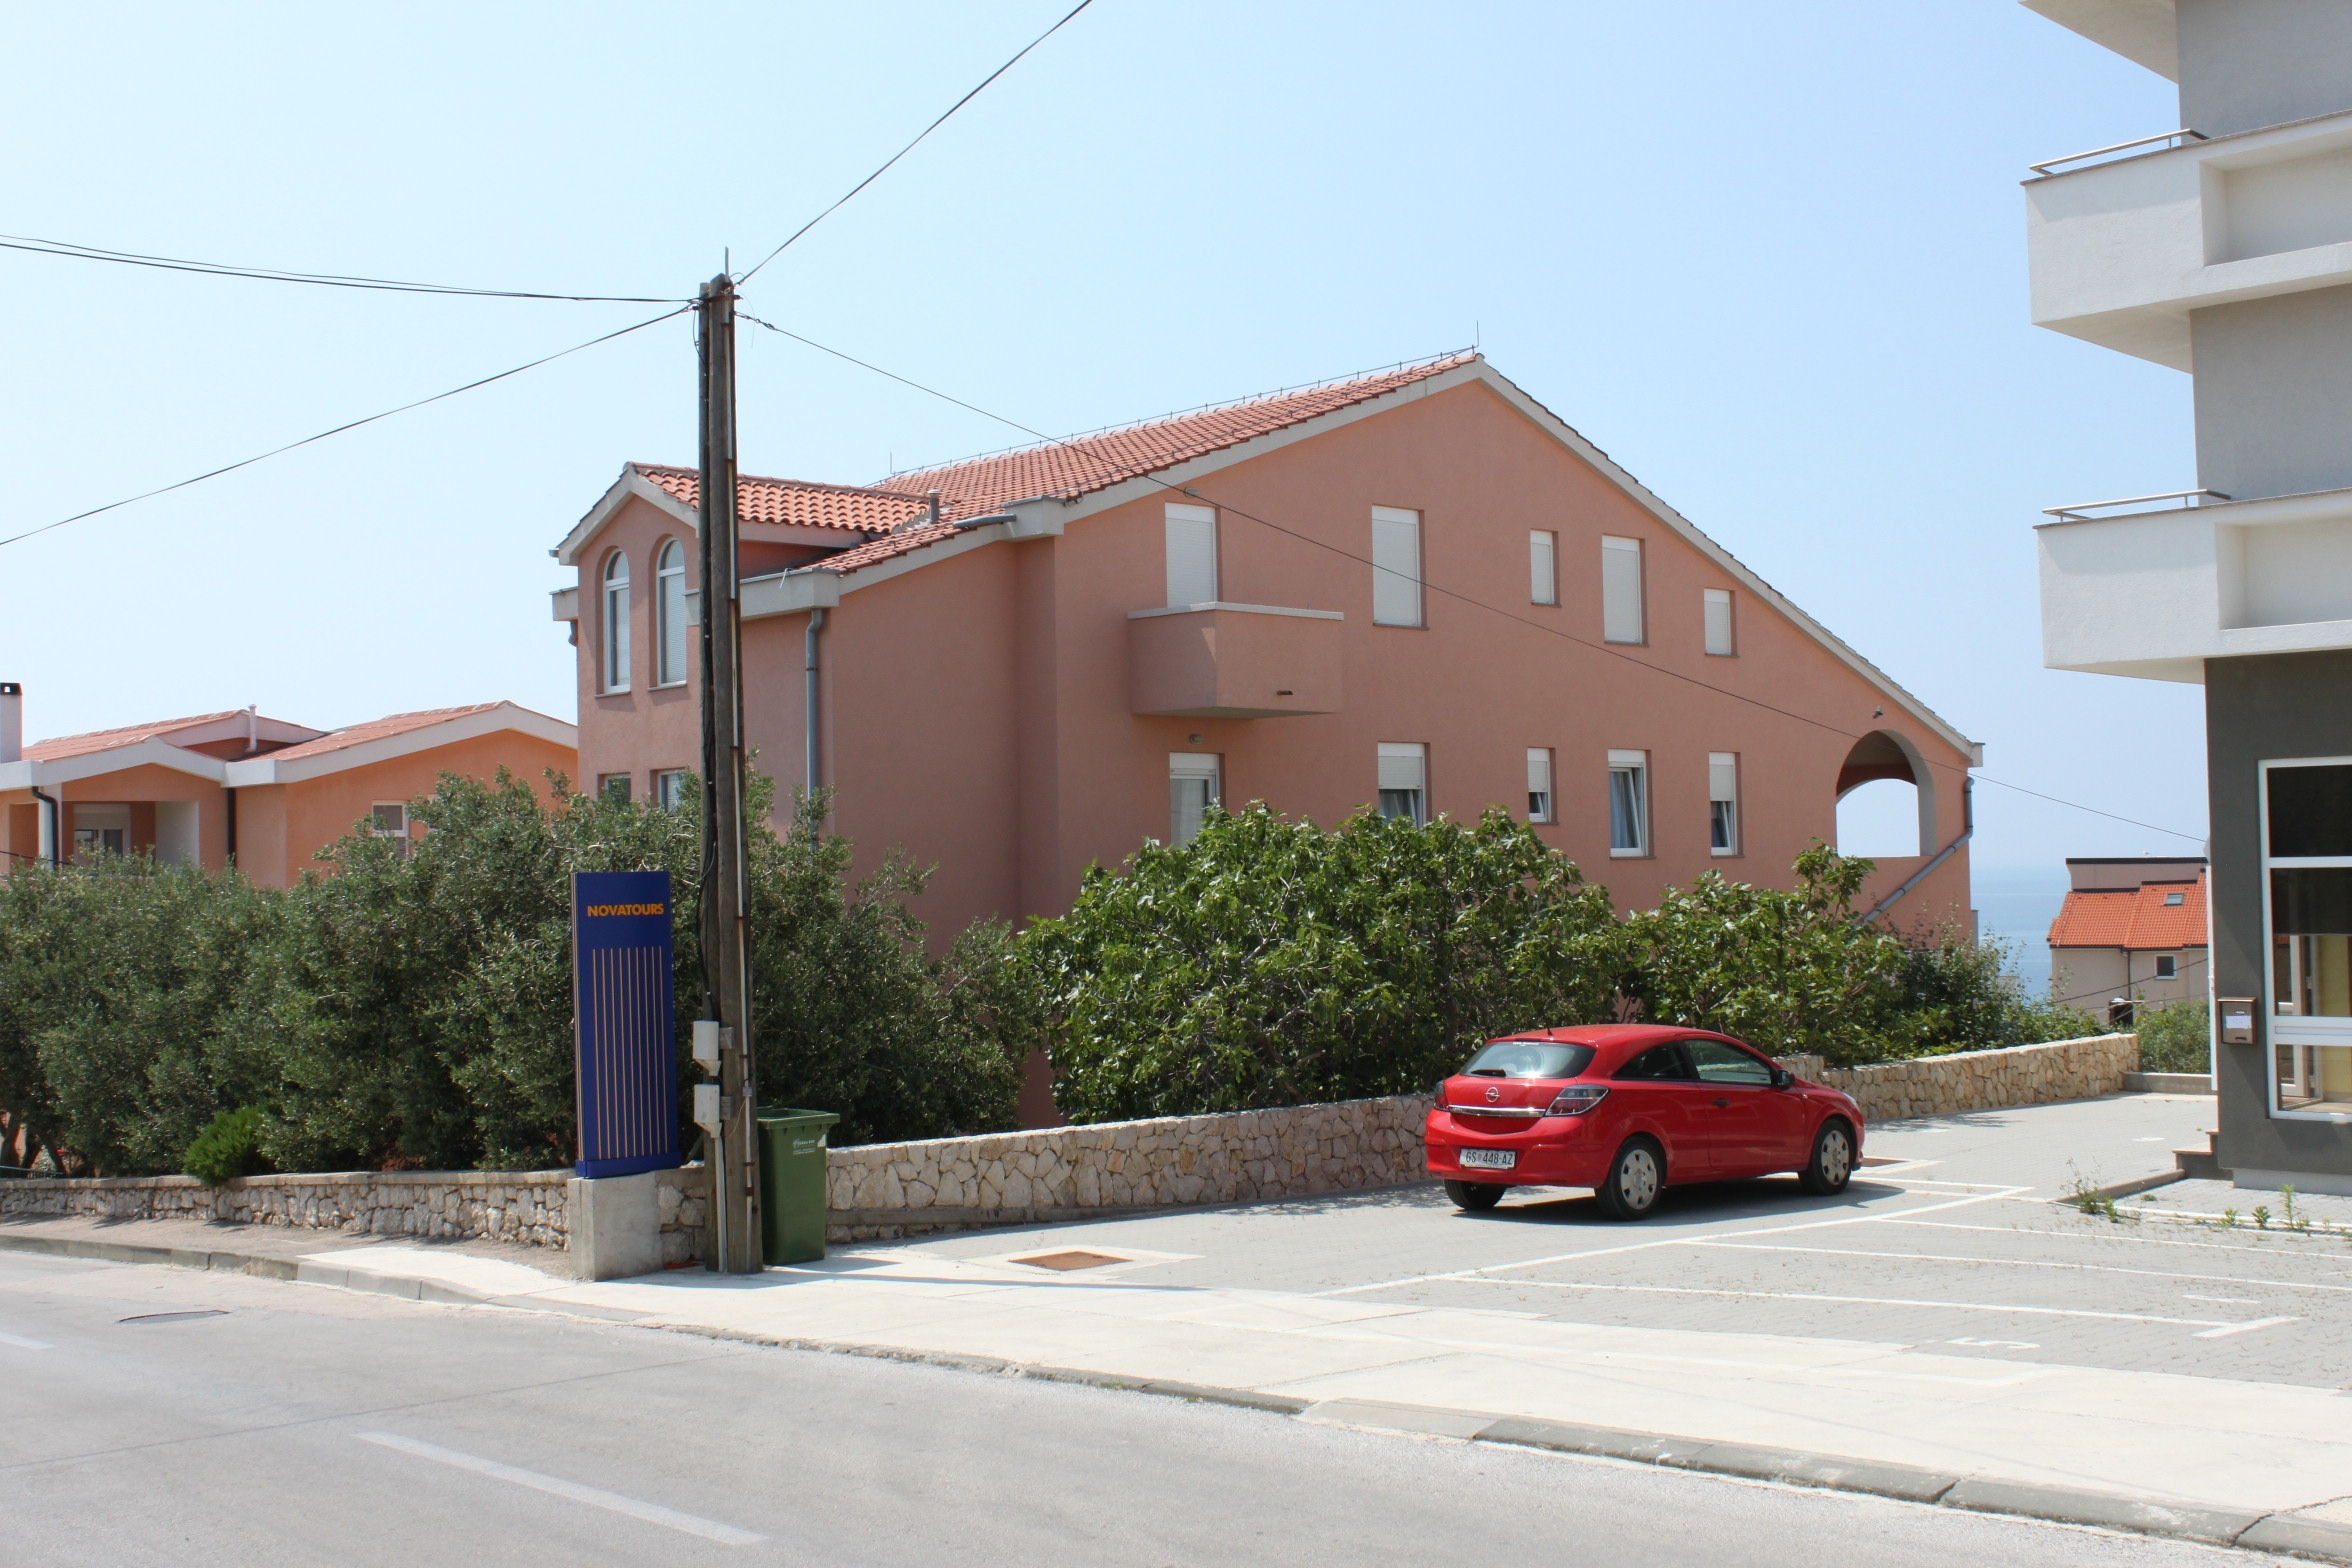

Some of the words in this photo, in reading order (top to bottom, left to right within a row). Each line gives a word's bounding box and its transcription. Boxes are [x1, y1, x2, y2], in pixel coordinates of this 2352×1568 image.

[587, 903, 664, 917] NOVATOURS
[1466, 1151, 1477, 1162] GS
[1482, 1152, 1513, 1165] 448-AZ
